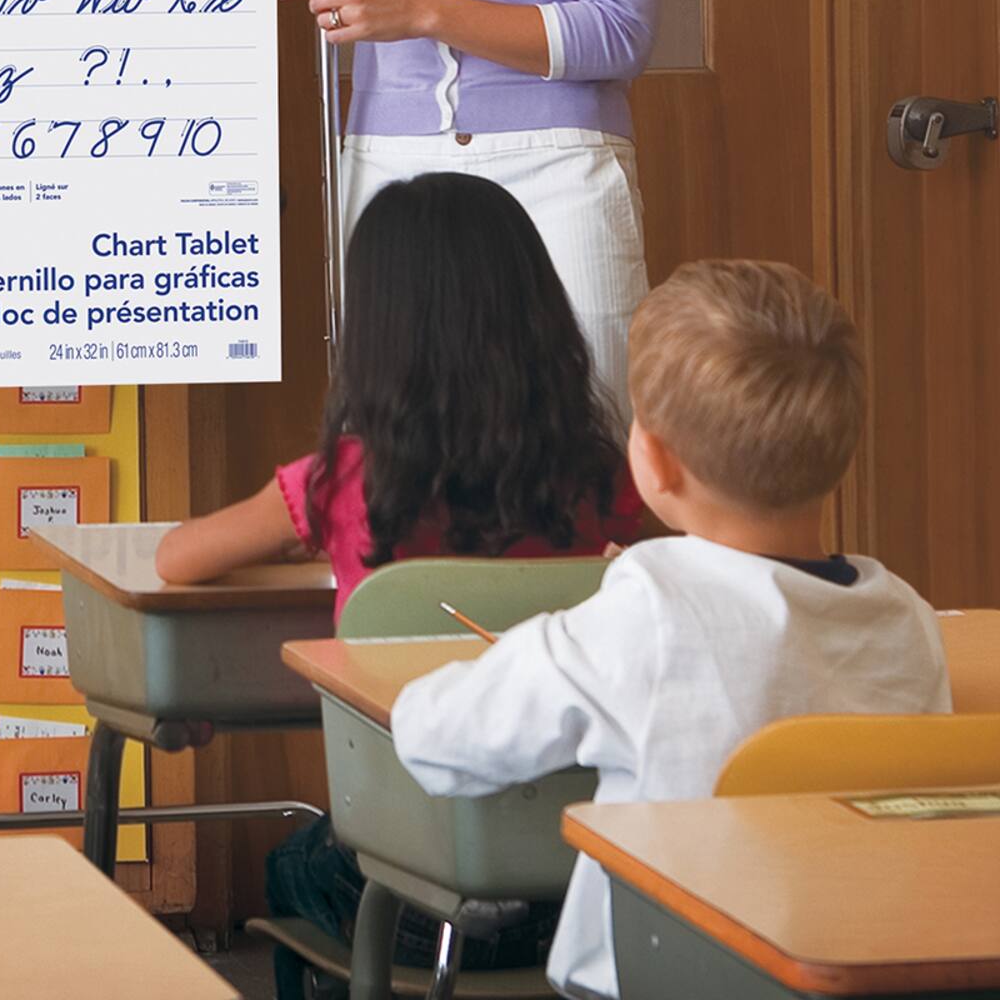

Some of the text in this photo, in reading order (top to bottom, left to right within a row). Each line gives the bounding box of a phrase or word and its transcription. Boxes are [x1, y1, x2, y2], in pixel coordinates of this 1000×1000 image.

[12, 121, 36, 159] 6
[52, 121, 82, 159] 7
[90, 119, 130, 158] 8
[140, 120, 165, 157] 9
[178, 119, 222, 157] 10
[2, 193, 22, 201] lados
[36, 193, 41, 201] 2
[92, 230, 259, 257] Chart Tablet
[85, 273, 144, 297] para
[154, 263, 259, 296] gráficas
[43, 300, 78, 325] de
[88, 298, 258, 331] présentation
[49, 345, 64, 360] 24
[65, 343, 75, 360] in
[83, 344, 98, 359] 32
[99, 343, 109, 359] in
[116, 343, 129, 358] 61
[131, 346, 148, 358] cm
[156, 342, 181, 357] 81.3
[182, 345, 198, 357] cm
[33, 505, 67, 515] Joshua
[36, 646, 63, 657] Noah
